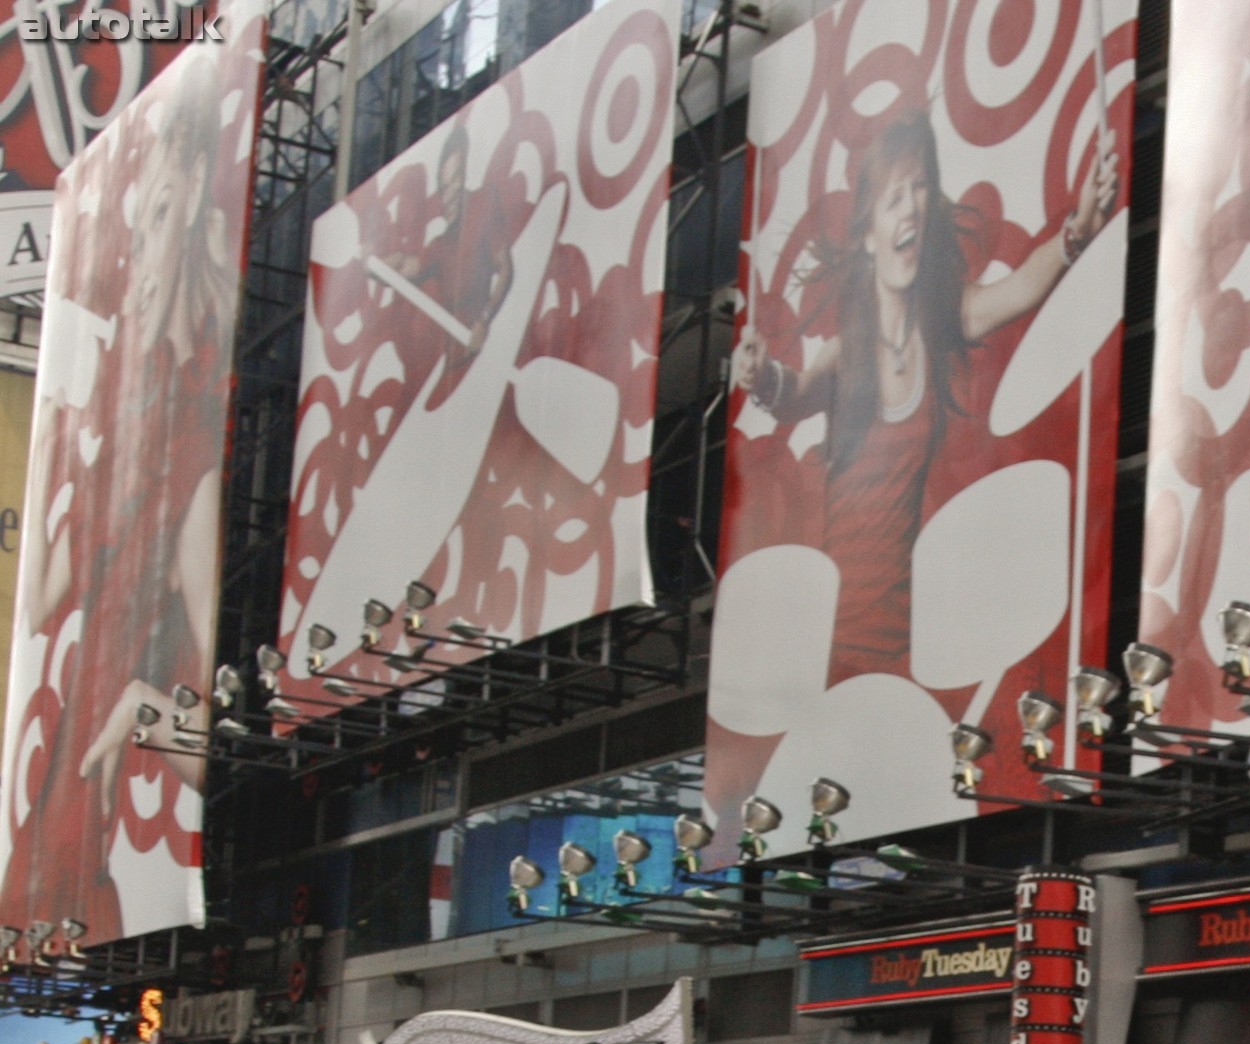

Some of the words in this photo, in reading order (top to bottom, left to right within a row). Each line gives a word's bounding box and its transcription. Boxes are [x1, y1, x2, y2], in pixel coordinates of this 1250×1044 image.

[870, 955, 923, 987] Ruby
[921, 942, 1014, 978] Tuesday
[1072, 884, 1097, 1024] Ruby
